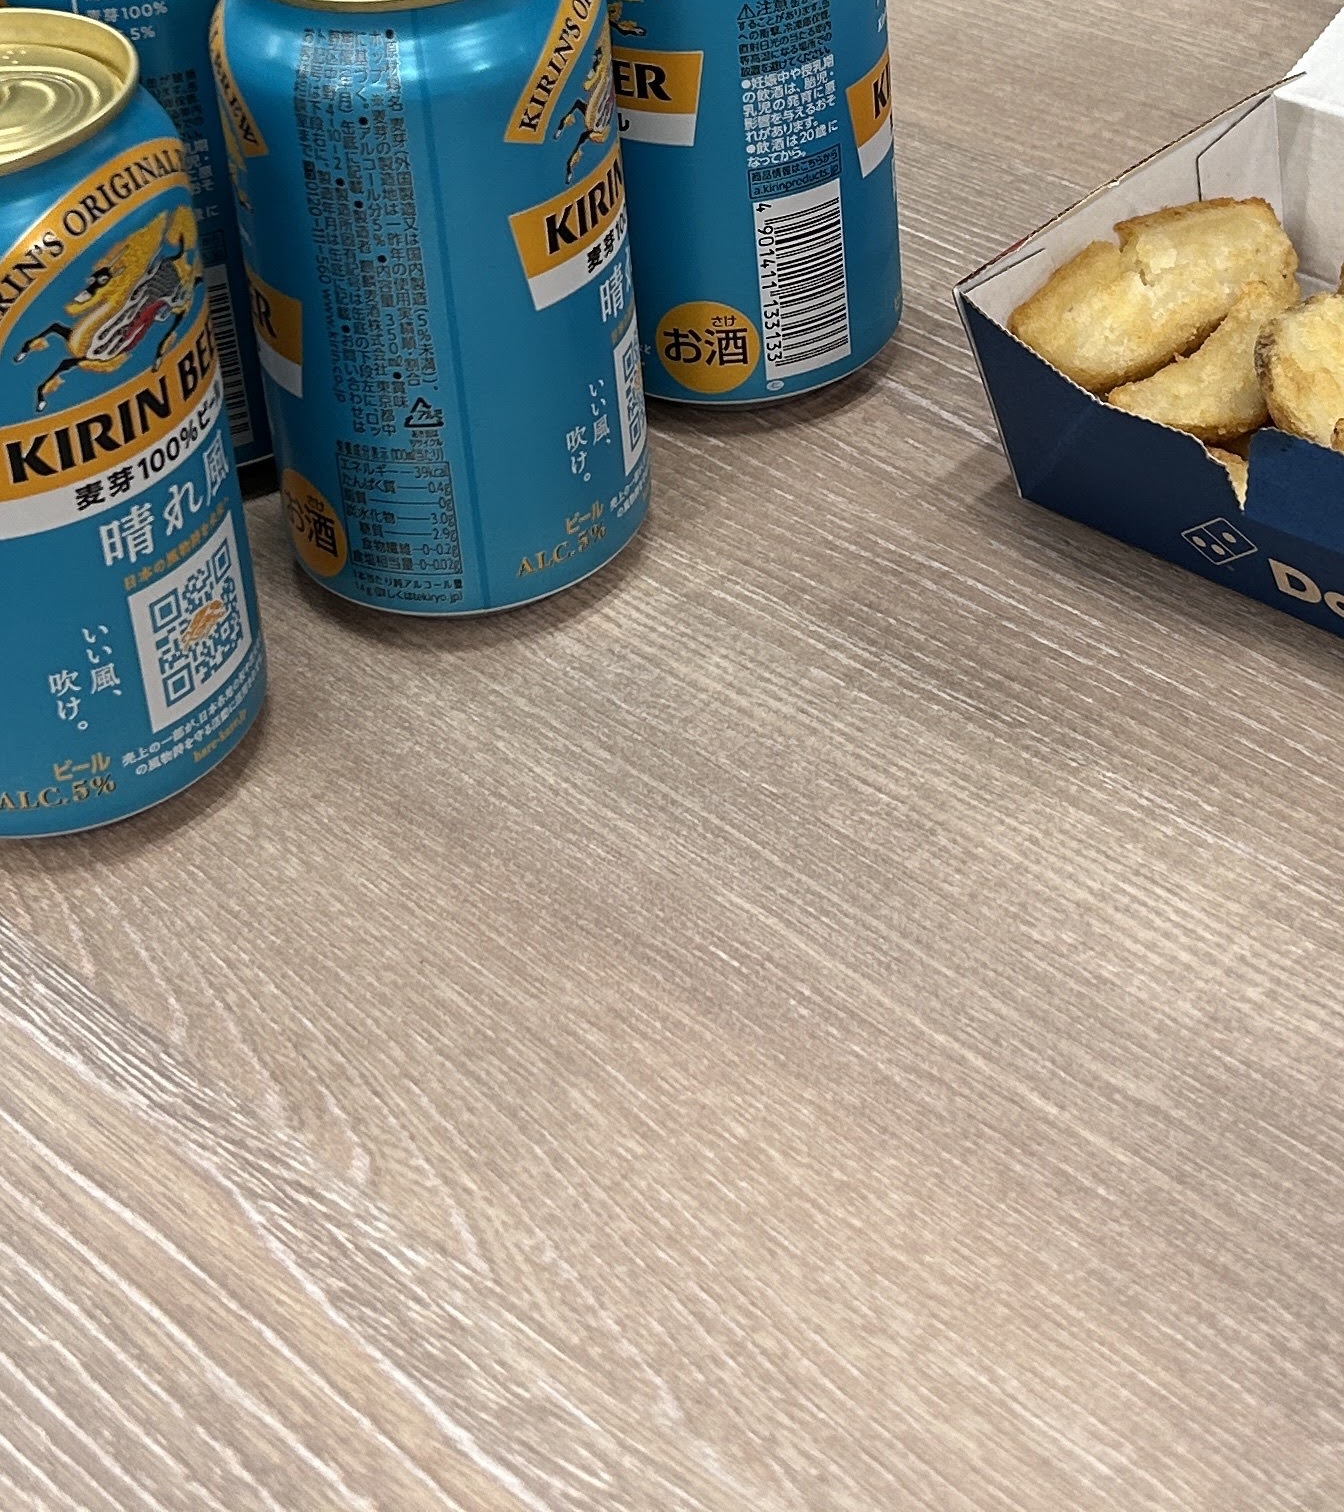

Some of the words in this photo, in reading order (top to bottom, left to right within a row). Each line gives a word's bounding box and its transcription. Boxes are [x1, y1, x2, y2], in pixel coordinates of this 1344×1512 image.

[519, 16, 582, 133] KIRIN'S
[663, 326, 749, 367] お酒
[5, 378, 173, 486] KIRIN
[565, 425, 592, 482] 吹け。
[98, 432, 232, 568] 晴れ風
[81, 623, 124, 697] いい風、
[47, 668, 89, 733] 吹け。
[52, 752, 111, 781] ビール
